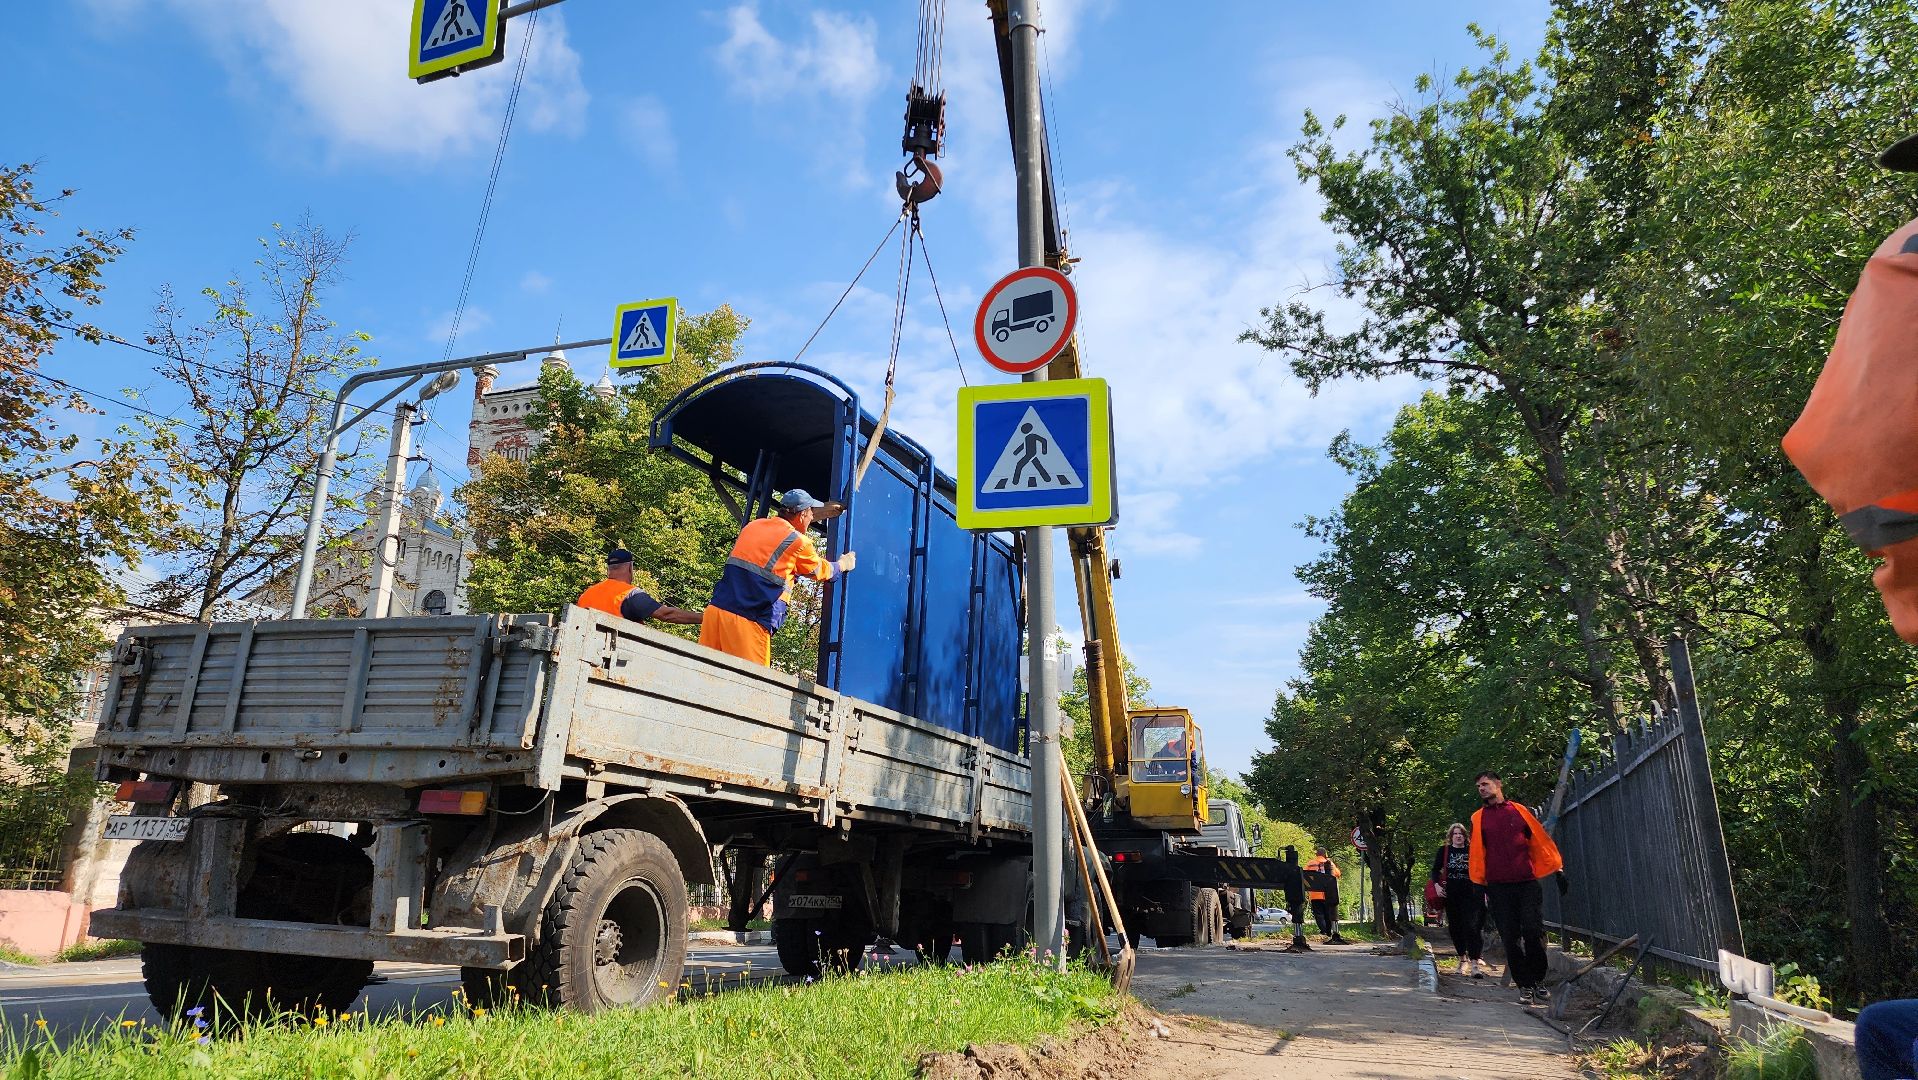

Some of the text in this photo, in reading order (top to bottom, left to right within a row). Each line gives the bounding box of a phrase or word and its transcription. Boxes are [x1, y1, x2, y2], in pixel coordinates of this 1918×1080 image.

[109, 819, 184, 837] АР 1137 50
